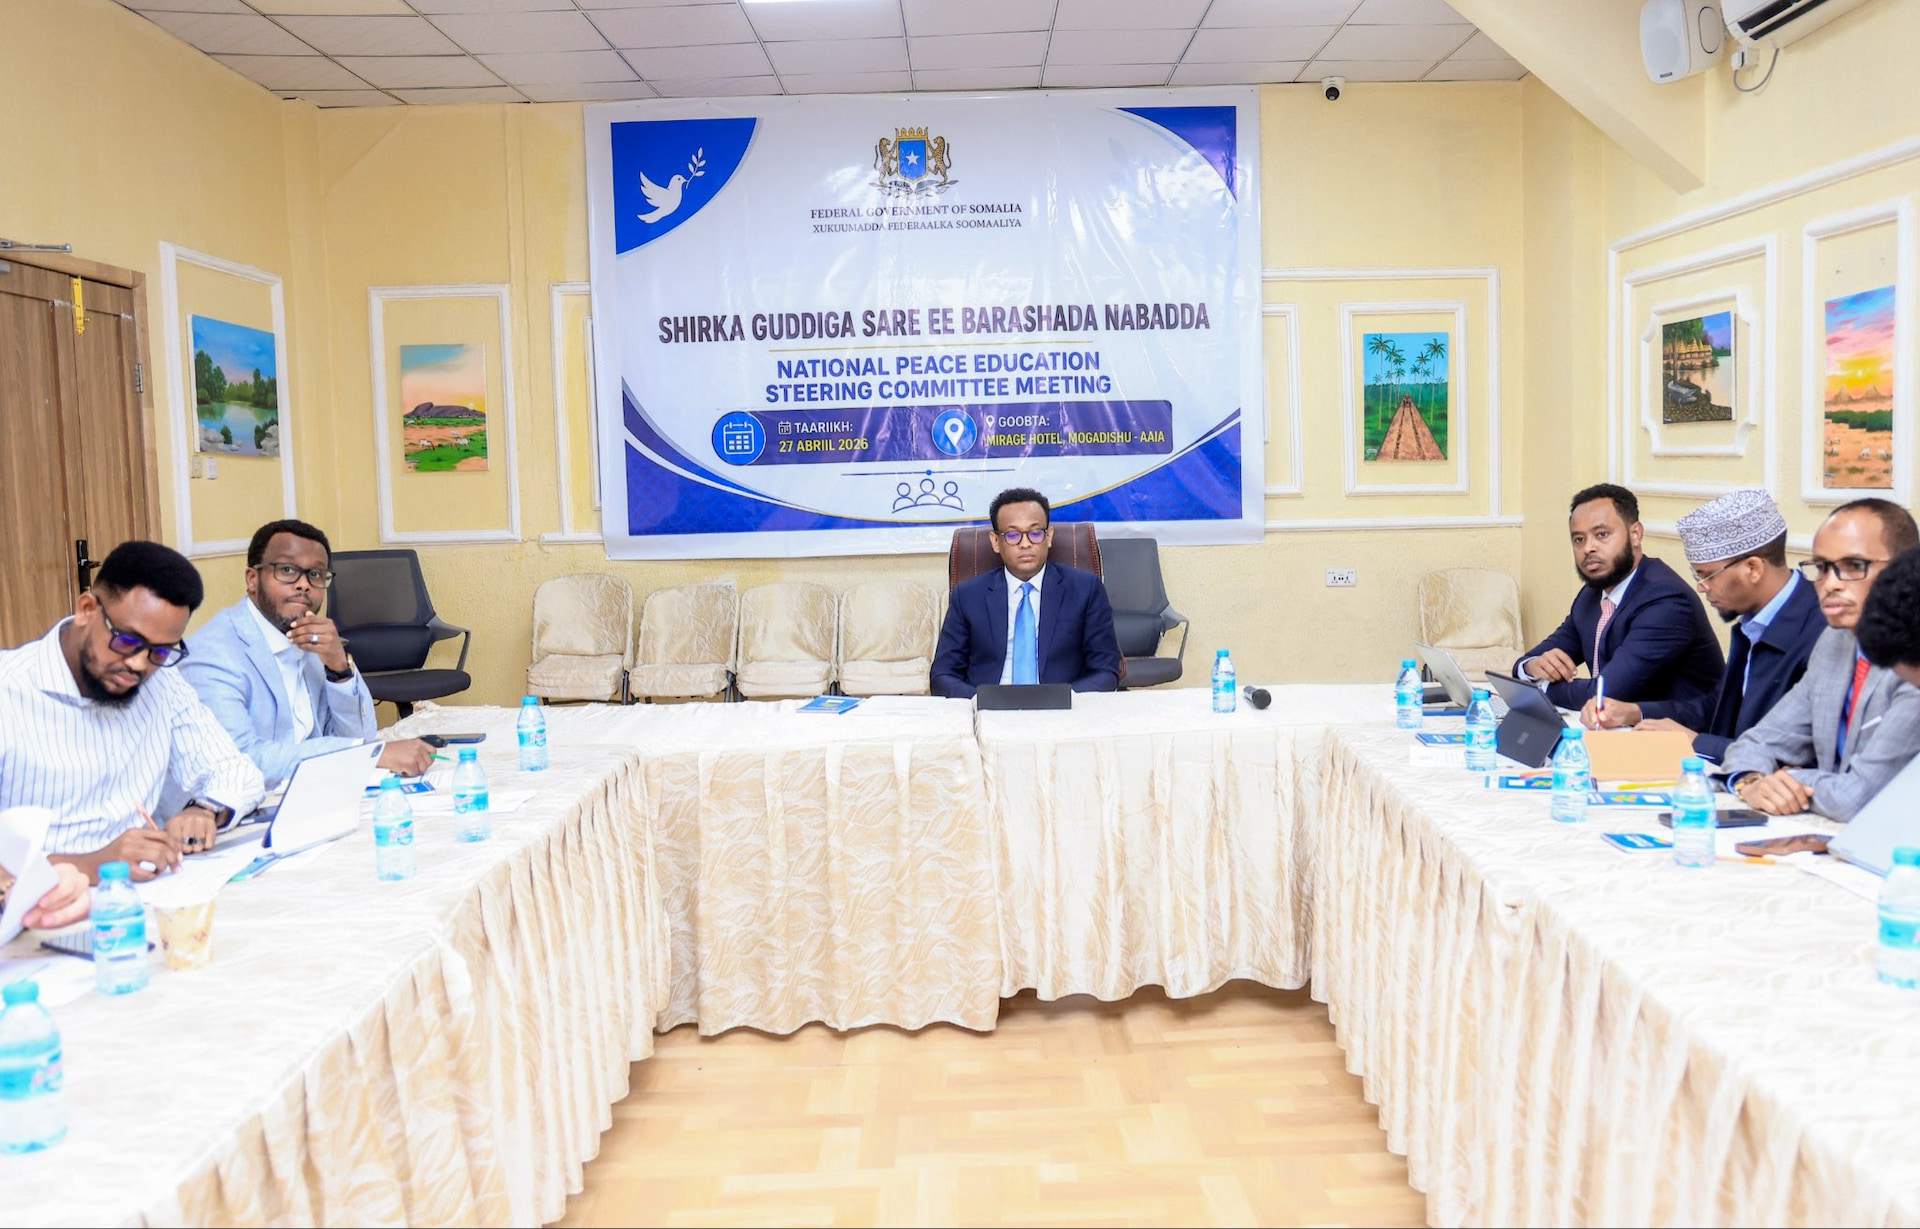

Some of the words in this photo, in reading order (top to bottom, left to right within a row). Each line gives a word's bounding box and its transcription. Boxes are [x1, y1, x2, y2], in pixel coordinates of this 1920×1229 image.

[811, 208, 863, 219] FEDERAL
[866, 205, 949, 217] GOVERNMENT
[951, 204, 967, 214] OF
[969, 203, 1022, 214] SOMALIA
[813, 222, 885, 233] XUKUUMADDA
[888, 220, 954, 231] FEDERAALKA
[956, 218, 1022, 229] SOOMAALIYA
[658, 314, 745, 343] SHIRKA
[752, 311, 856, 341] GUDDIGA
[862, 308, 921, 337] SARE
[928, 307, 955, 335] EE
[962, 304, 1099, 334] BARASHADA
[1105, 302, 1211, 331] NABADDA
[777, 357, 890, 379] NATIONAL
[896, 354, 967, 375] PEACE
[974, 351, 1100, 373] EDUCATION
[766, 381, 873, 403] STEERING
[878, 377, 1009, 399] COMMITTEE
[1016, 374, 1111, 395] MEETING
[794, 421, 853, 434] TAARIIKH:
[998, 415, 1050, 428] GOOBTA:
[779, 440, 793, 453] 27
[796, 438, 836, 452] ABRIIL
[838, 438, 869, 451] 2026
[986, 433, 1025, 446] MIRAGE
[1030, 432, 1066, 446] HOTEL,
[1068, 431, 1131, 444] MOGADISHU
[1140, 430, 1165, 443] AAIA
